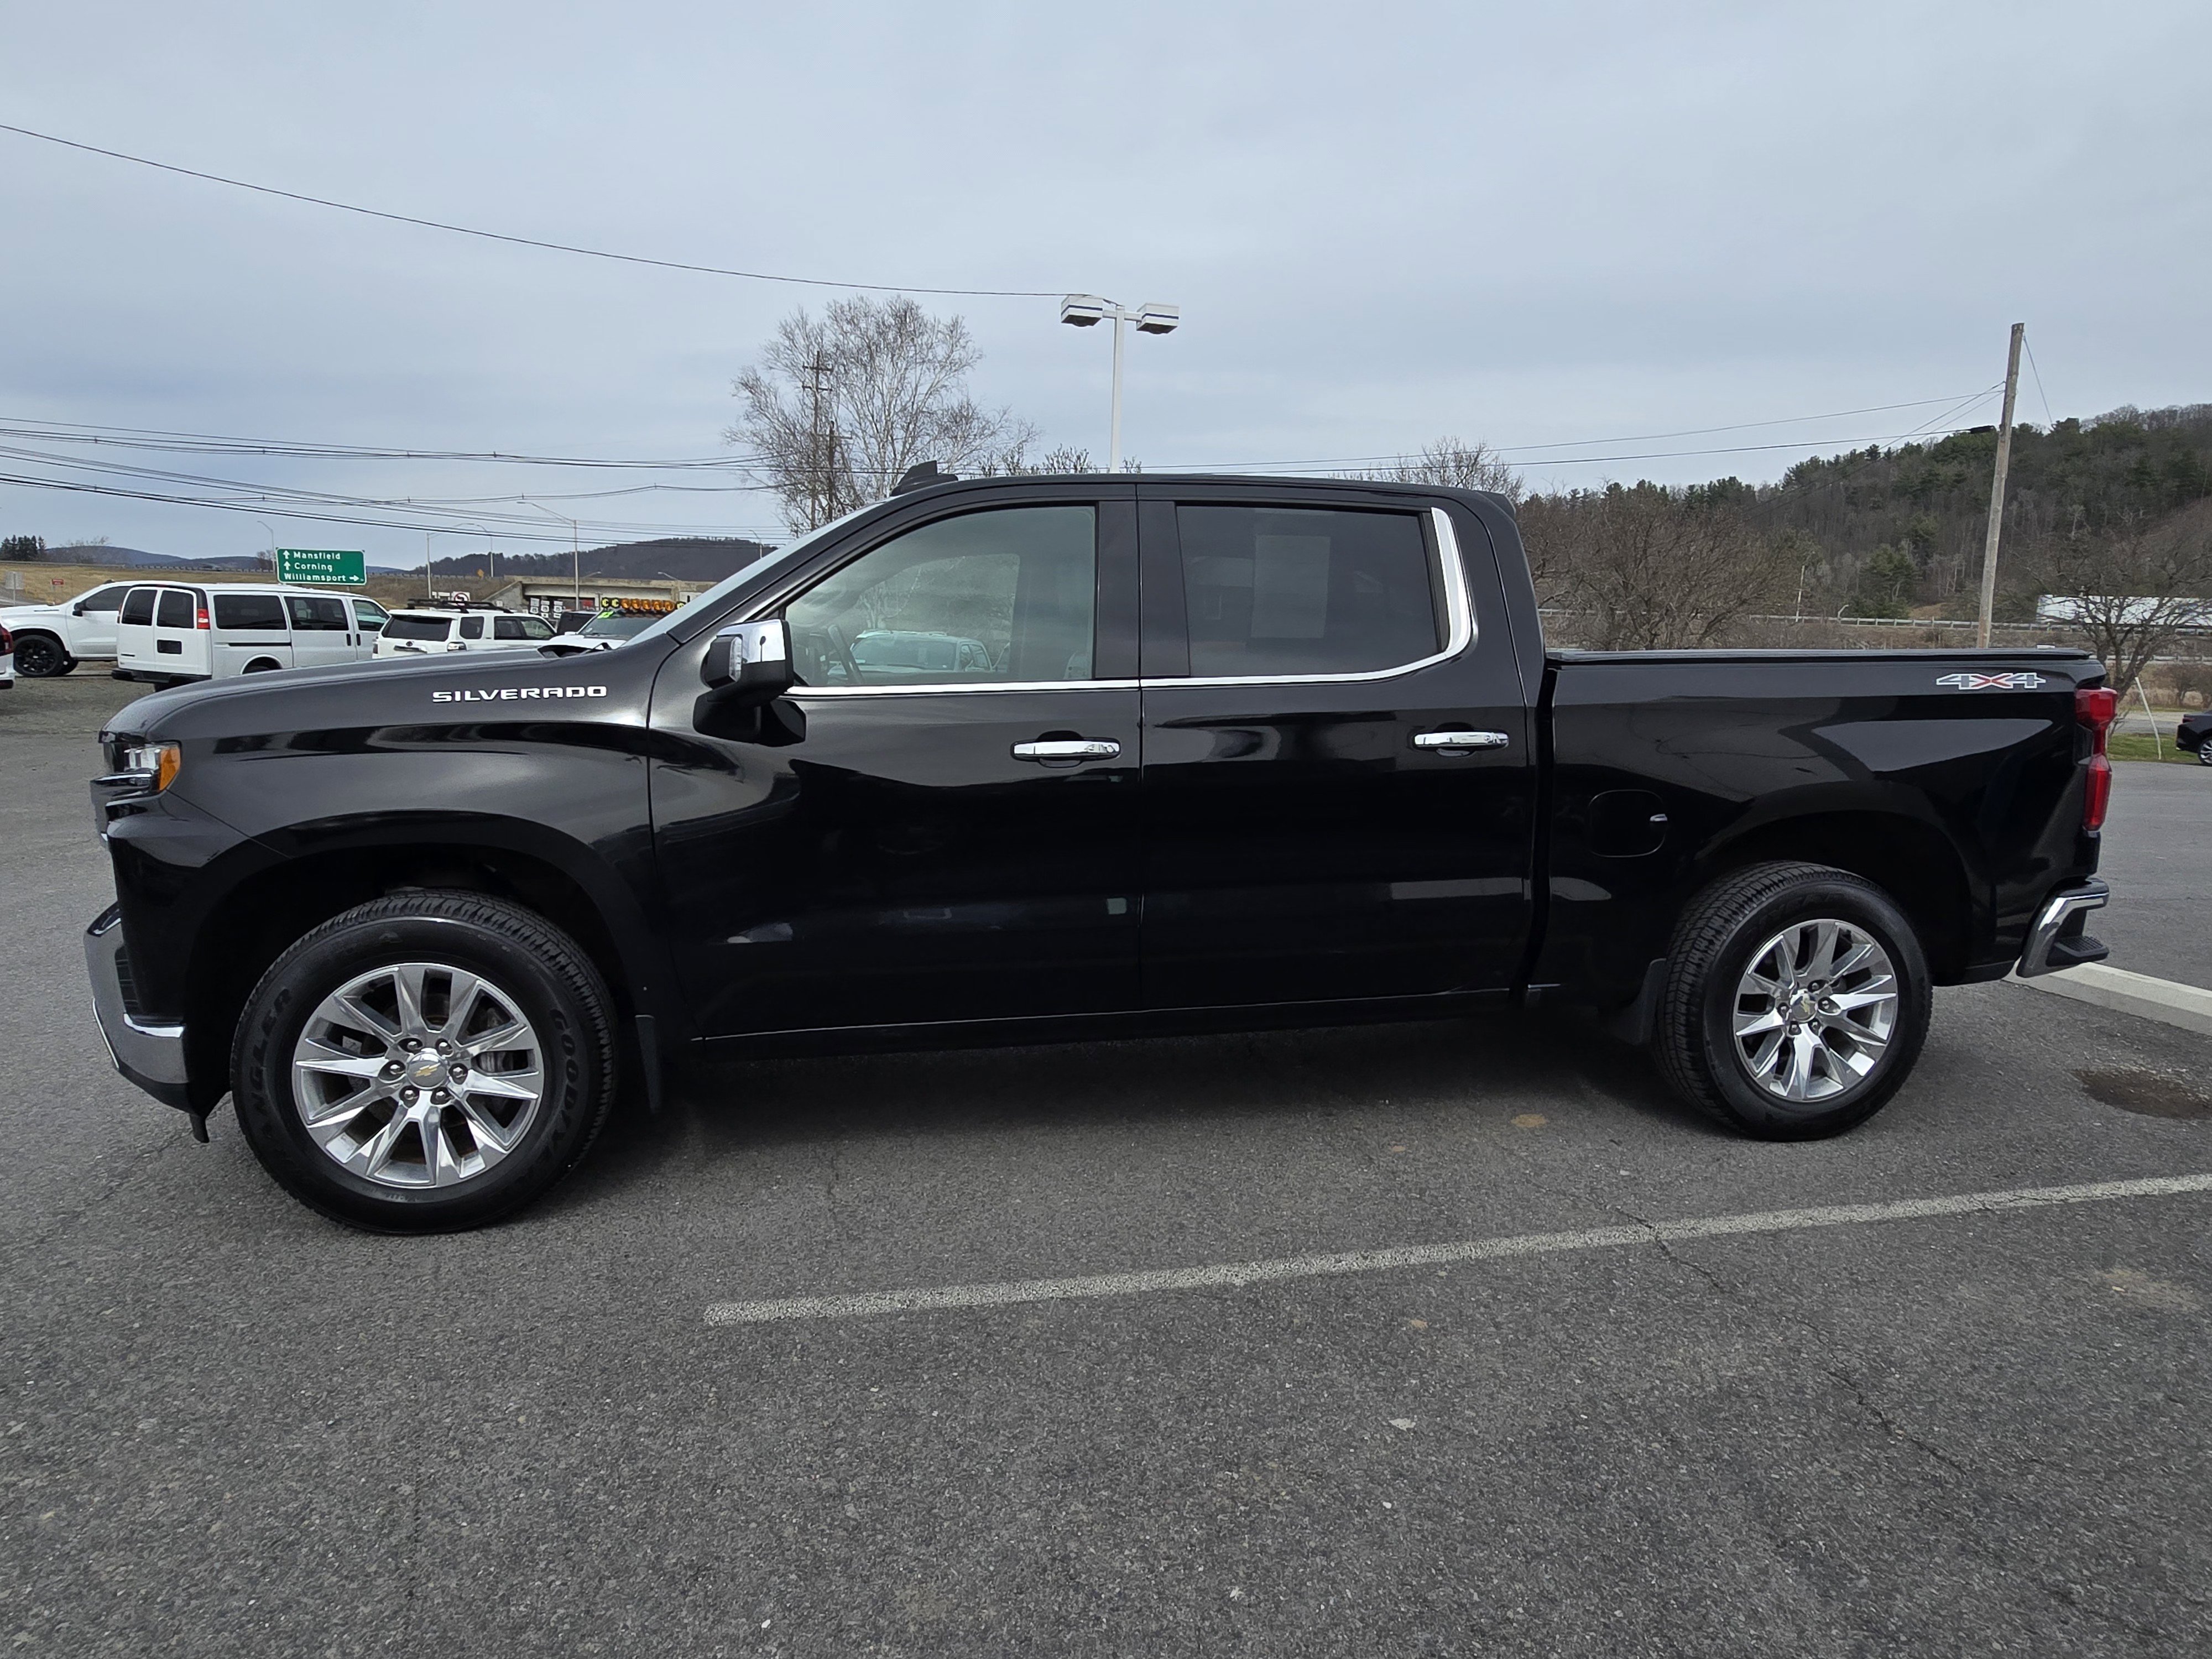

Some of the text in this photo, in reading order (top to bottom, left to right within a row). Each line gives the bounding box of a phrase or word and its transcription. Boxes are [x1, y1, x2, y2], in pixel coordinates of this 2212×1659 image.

[293, 551, 341, 560] Mansfield
[294, 562, 333, 572] Corning
[284, 573, 346, 582] Williamsport
[432, 686, 607, 703] SILVERADO
